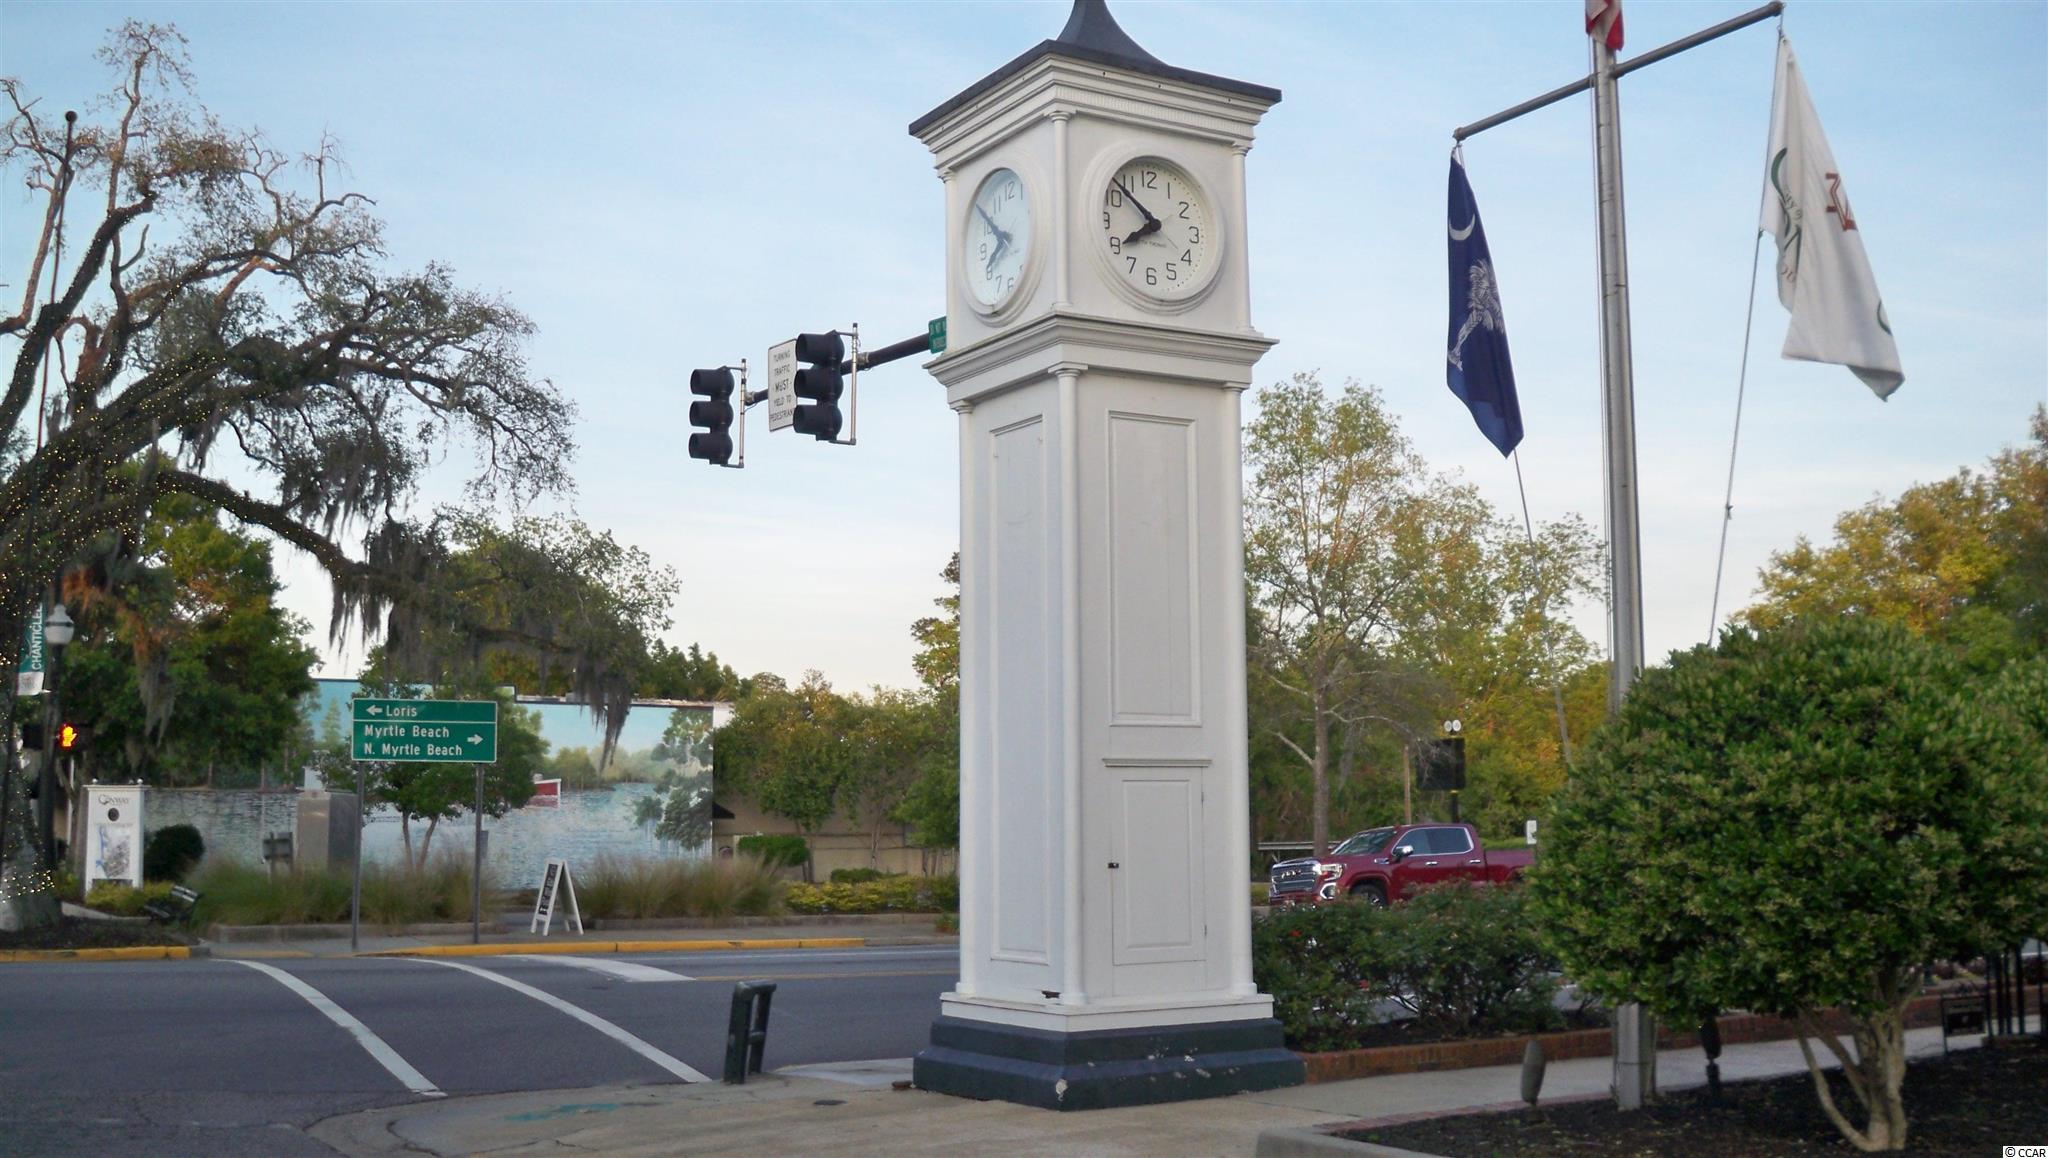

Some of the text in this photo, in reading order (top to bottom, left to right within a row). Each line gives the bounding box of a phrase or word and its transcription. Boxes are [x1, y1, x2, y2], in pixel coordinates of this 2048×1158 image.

[1122, 174, 1134, 194] 11
[1141, 170, 1157, 190] 12
[1004, 180, 1015, 202] 12
[1105, 188, 1122, 208] 10
[993, 194, 1001, 215] 11
[1178, 201, 1190, 220] 2
[1188, 226, 1200, 244] 3
[979, 243, 988, 261] 9
[1110, 236, 1121, 255] 8
[1126, 255, 1137, 274] 7
[1180, 248, 1192, 267] 4
[1146, 267, 1157, 286] 6
[1166, 262, 1177, 281] 5
[995, 275, 1002, 294] 7
[774, 364, 790, 376] TRAFFIC
[775, 378, 789, 393] MUST
[385, 704, 418, 717] Loris
[364, 724, 450, 739] Myrtle Beach
[363, 742, 462, 757] N. Myrtle Beach
